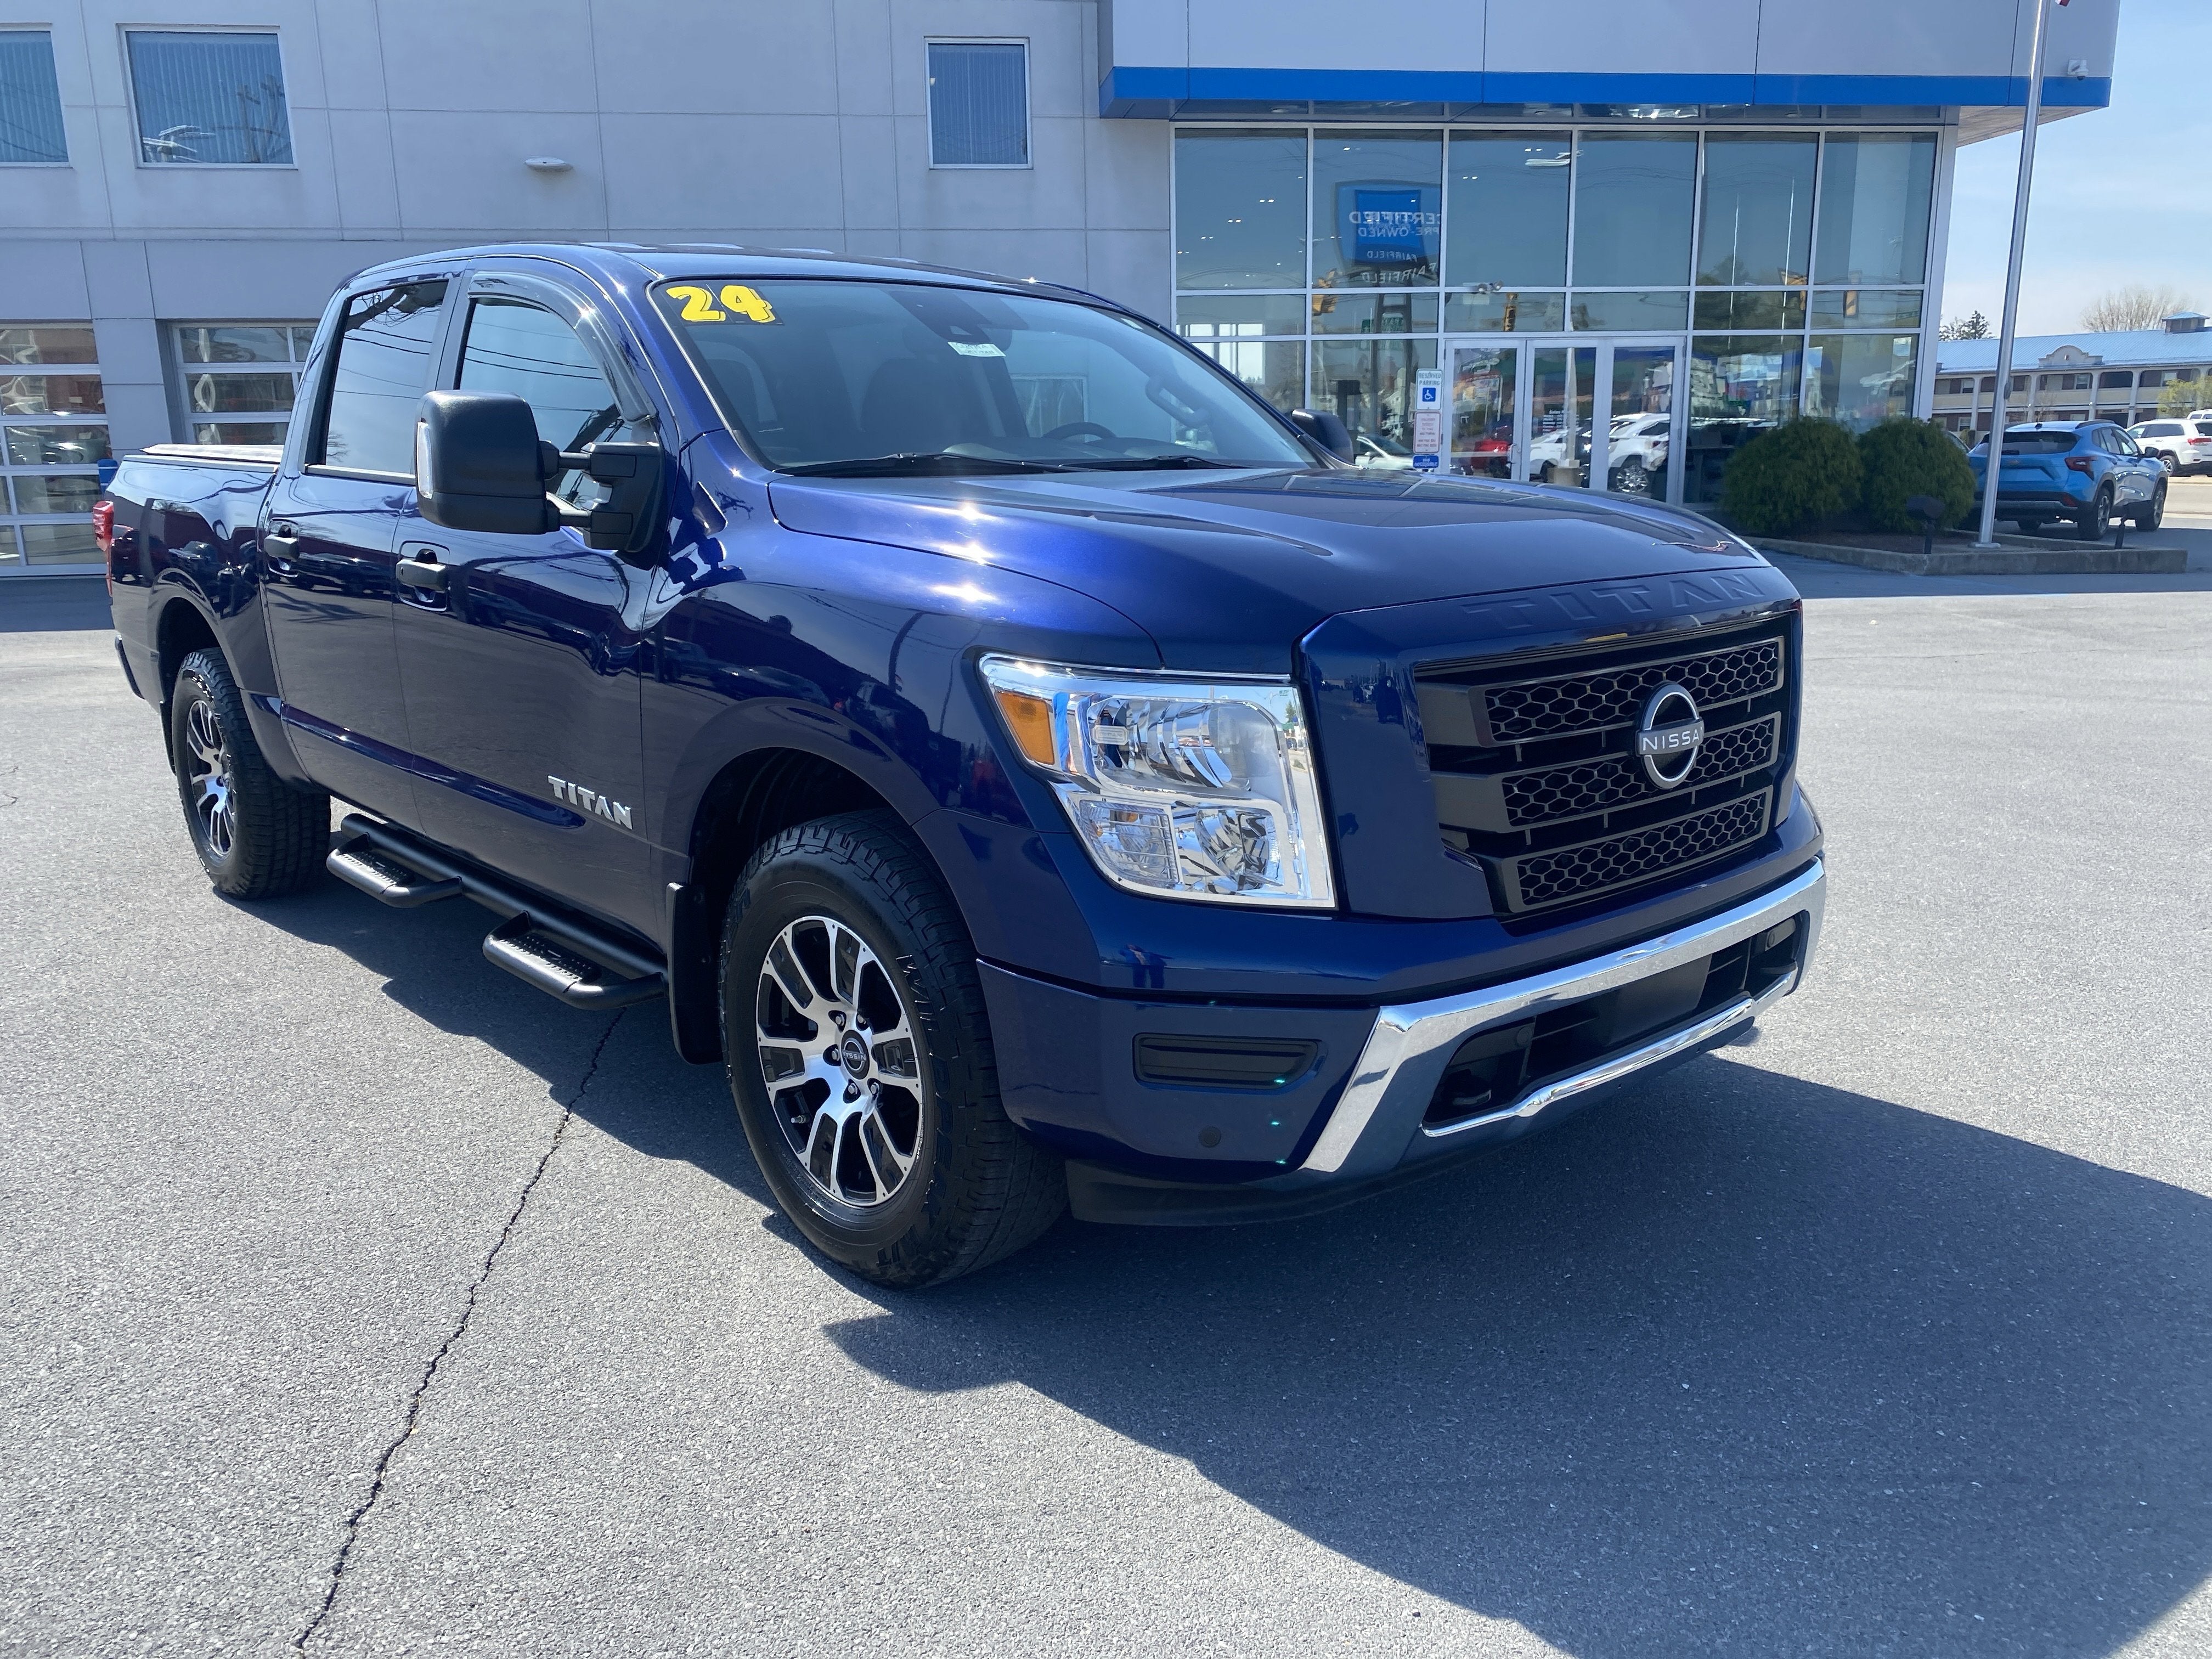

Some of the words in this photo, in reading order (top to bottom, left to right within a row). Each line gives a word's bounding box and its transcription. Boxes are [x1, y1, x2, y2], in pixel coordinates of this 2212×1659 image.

[665, 285, 776, 323] 24
[1461, 574, 1765, 629] TITAN
[548, 775, 633, 830] TITAN
